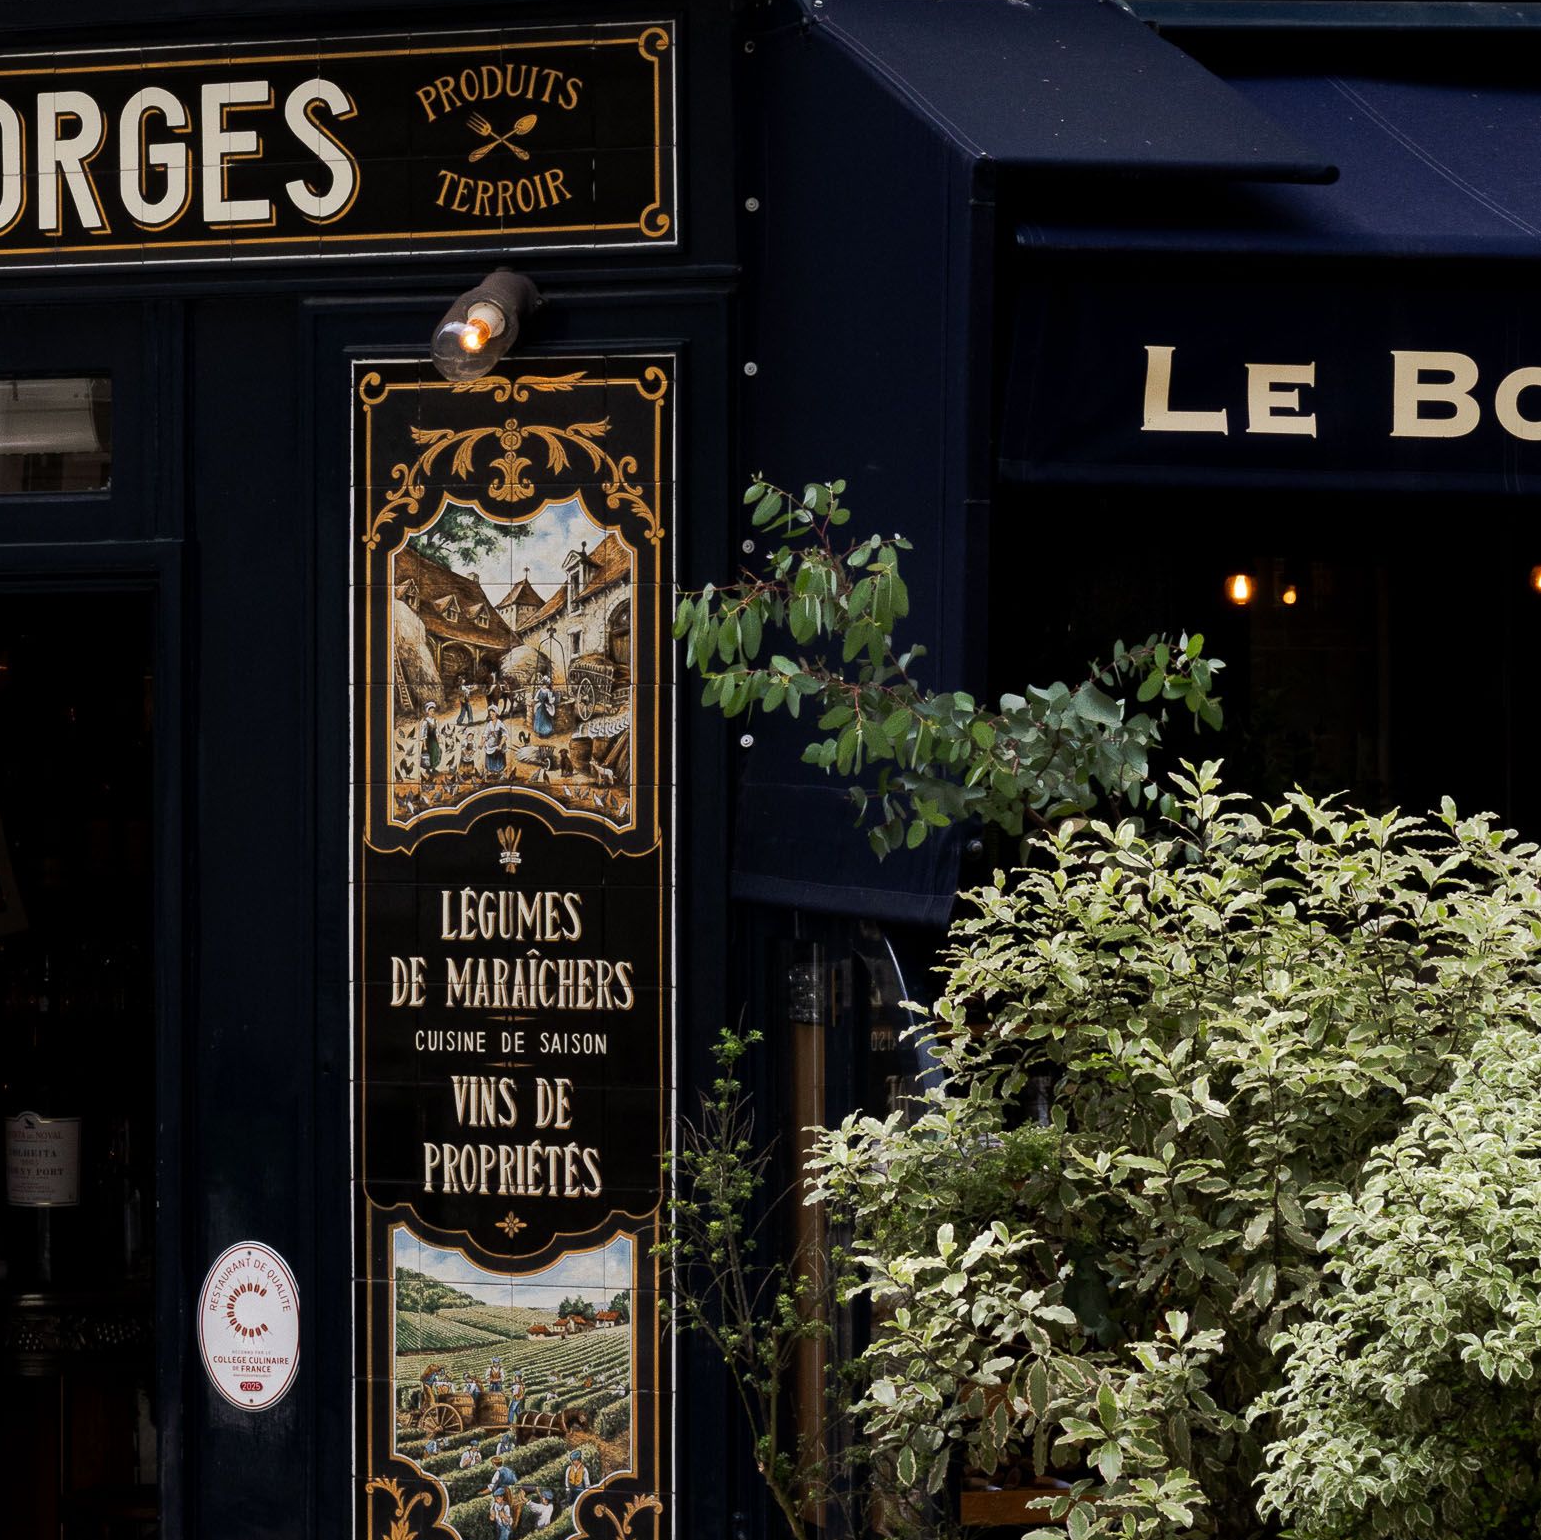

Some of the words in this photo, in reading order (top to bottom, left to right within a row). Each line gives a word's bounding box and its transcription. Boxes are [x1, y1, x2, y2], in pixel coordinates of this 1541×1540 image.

[416, 64, 583, 122] PRODUITS
[436, 168, 573, 217] TERROIR
[441, 887, 583, 942] LÉGUMES
[390, 956, 427, 1007] DE
[446, 948, 634, 1011] MARAÎCHERS
[415, 1030, 486, 1053] CUISINE
[501, 1030, 525, 1054] DE
[540, 1032, 607, 1055] SAISON
[451, 1075, 517, 1128] VINS
[535, 1078, 573, 1130] DE
[423, 1139, 602, 1198] PROPRIÉTÉS
[210, 1258, 251, 1312] RESTAURANT
[254, 1259, 268, 1273] DE
[241, 1365, 271, 1373] FRANCE
[241, 1382, 261, 1391] 2025
[248, 1356, 289, 1366] CULINAIRE
